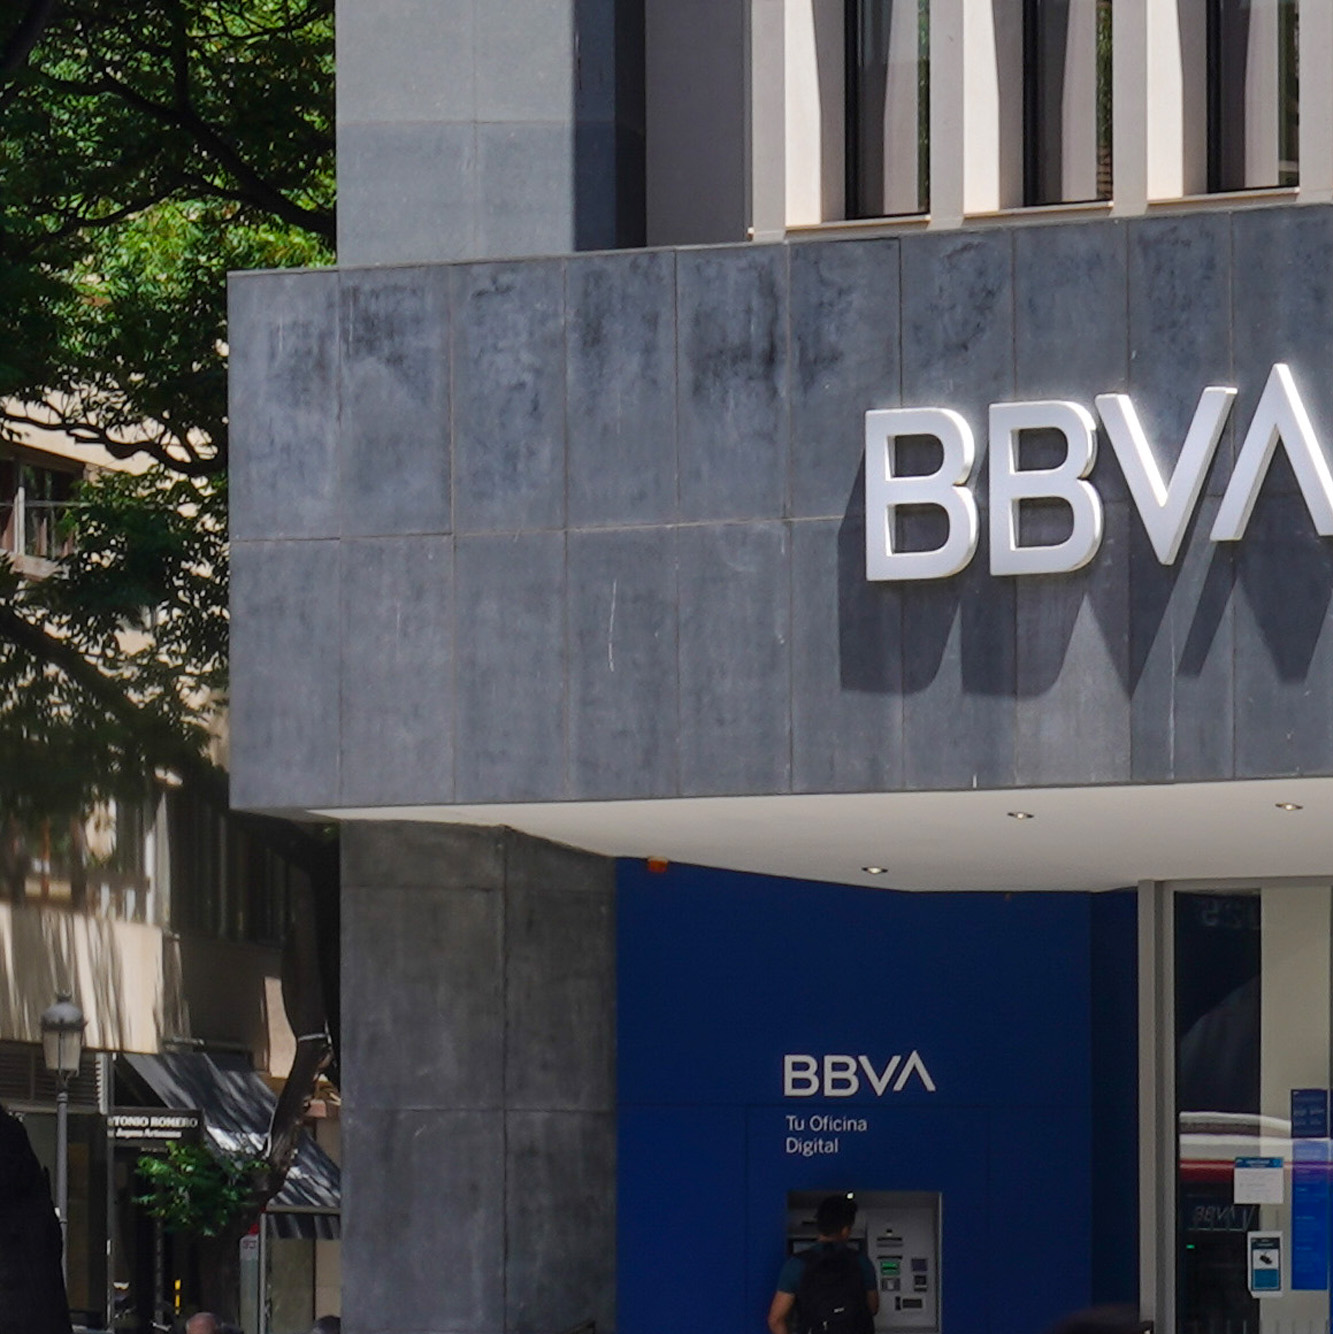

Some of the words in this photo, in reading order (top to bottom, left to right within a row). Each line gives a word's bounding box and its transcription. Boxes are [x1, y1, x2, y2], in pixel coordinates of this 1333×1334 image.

[784, 1050, 936, 1097] BBVA
[785, 1115, 805, 1131] Tu
[809, 1114, 868, 1131] Oficina
[785, 1137, 839, 1157] Digital
